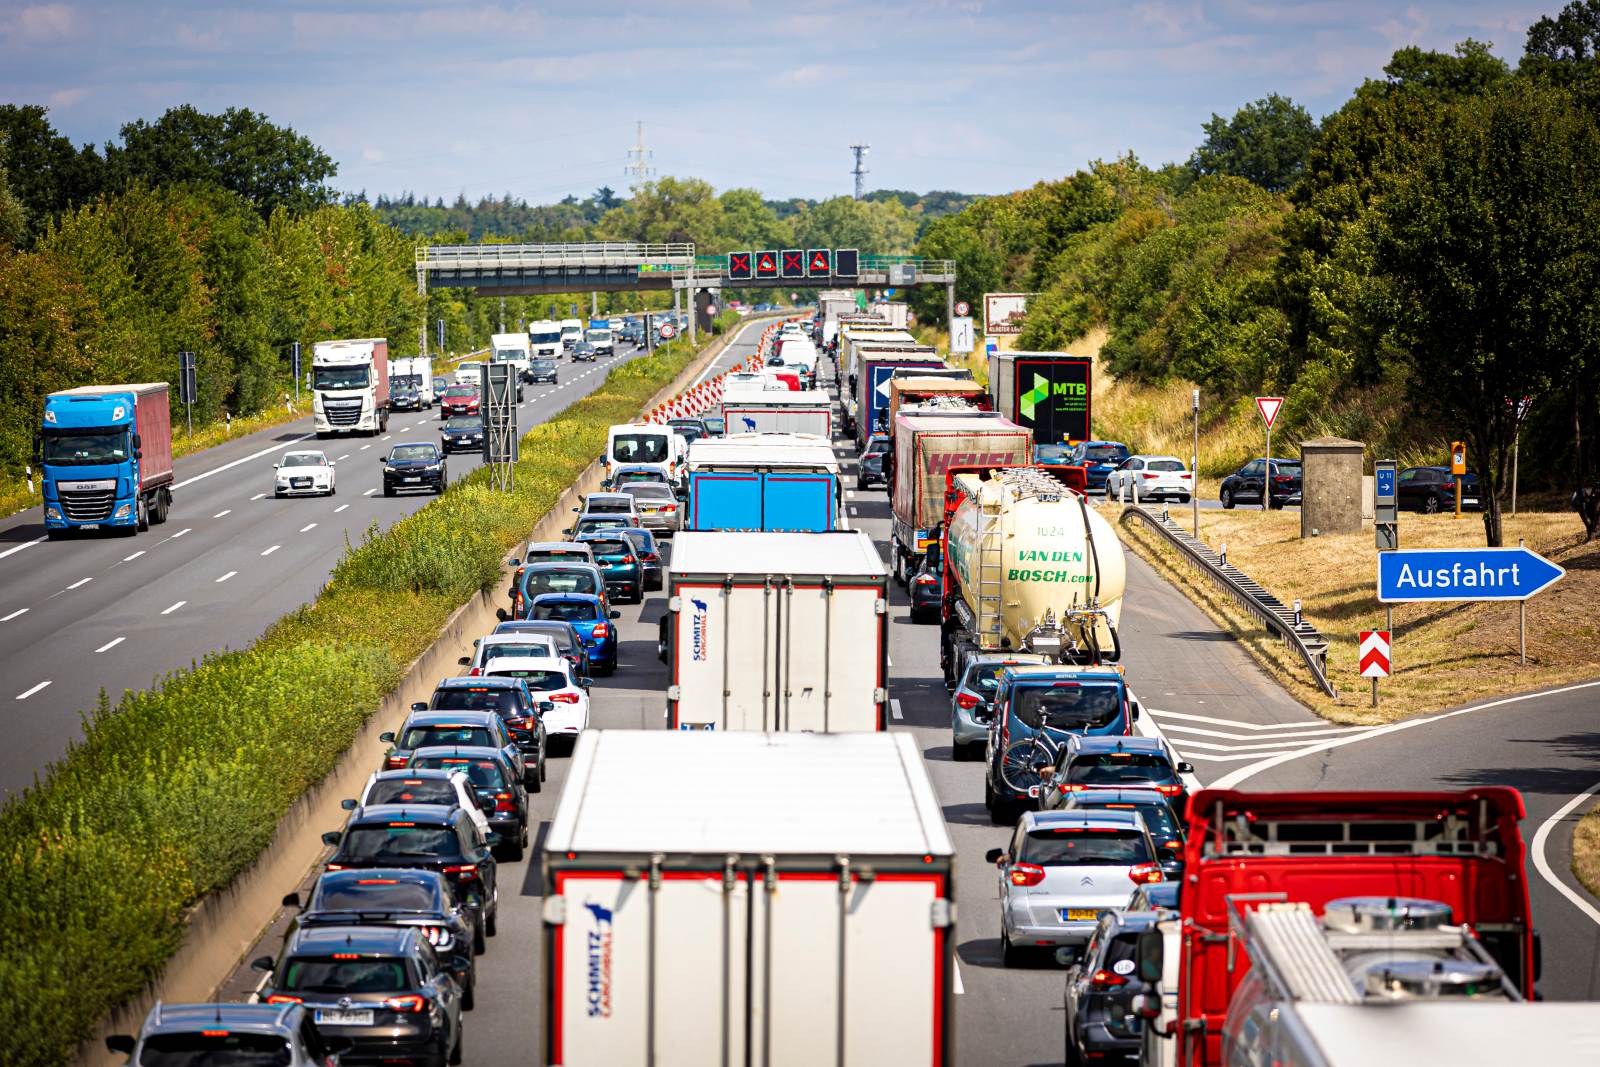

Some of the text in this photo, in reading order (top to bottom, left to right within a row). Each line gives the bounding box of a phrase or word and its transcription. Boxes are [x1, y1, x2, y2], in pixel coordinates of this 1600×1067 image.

[1053, 383, 1086, 395] MTB
[1041, 494, 1057, 502] LAG
[1019, 550, 1083, 562] VAN DEN
[1396, 562, 1520, 588] Ausfahrt
[588, 931, 600, 1017] SCHMITZ
